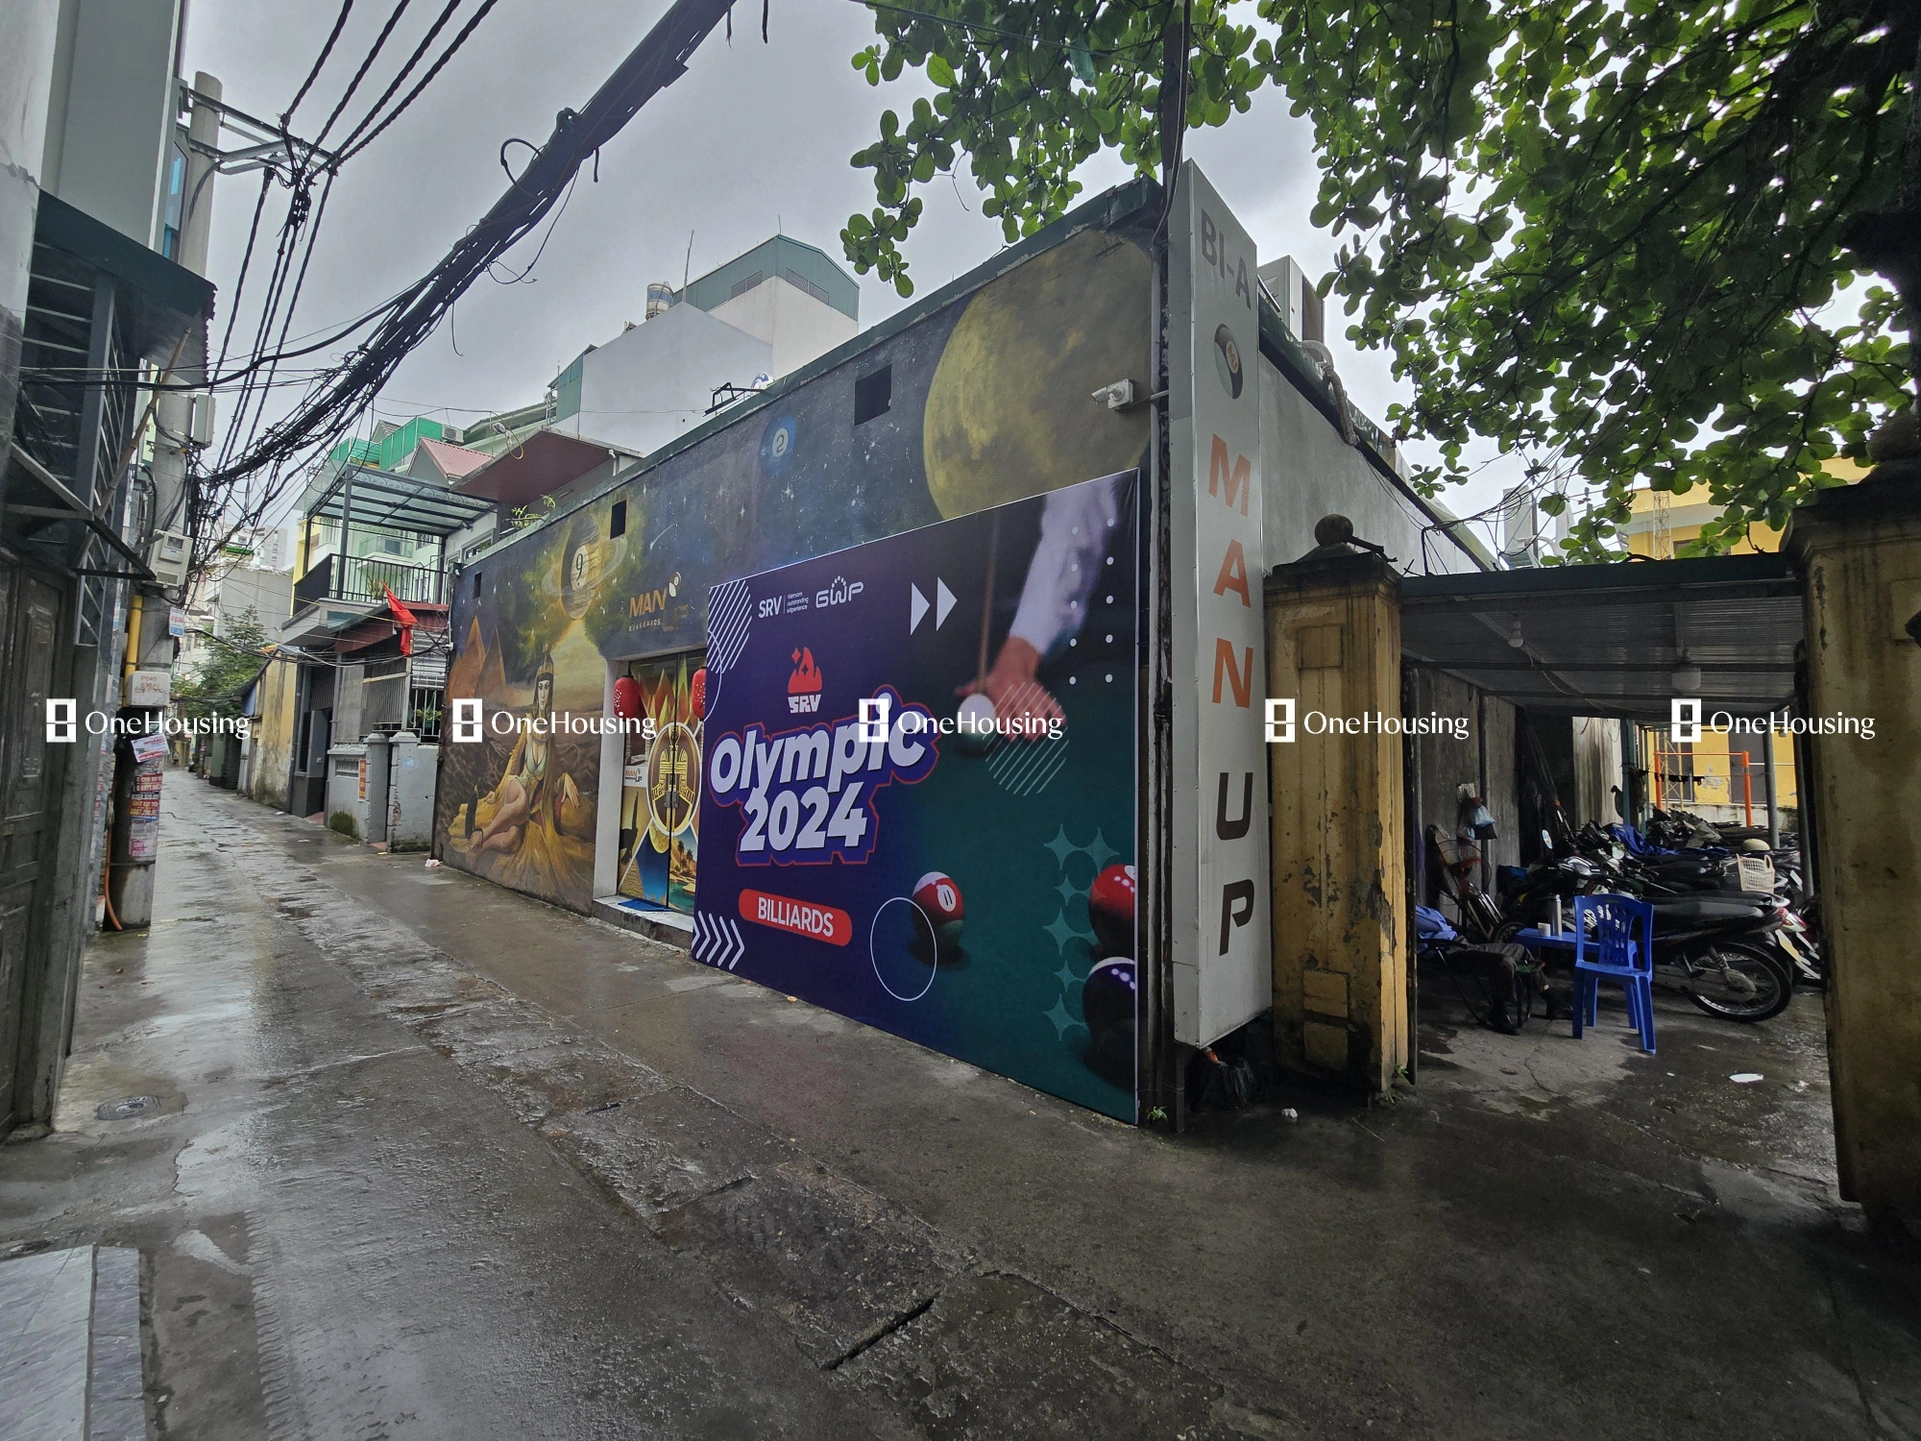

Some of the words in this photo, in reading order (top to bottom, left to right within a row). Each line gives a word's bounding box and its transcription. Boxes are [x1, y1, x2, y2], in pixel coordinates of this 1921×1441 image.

[1201, 208, 1251, 310] BI-A
[776, 433, 785, 454] 2
[1207, 432, 1253, 709] MAN
[629, 587, 668, 619] MAN
[758, 595, 783, 619] SRV
[787, 694, 821, 713] SRV
[740, 781, 867, 852] 2024
[1216, 771, 1255, 957] UP
[757, 896, 834, 938] BILLIARDS
